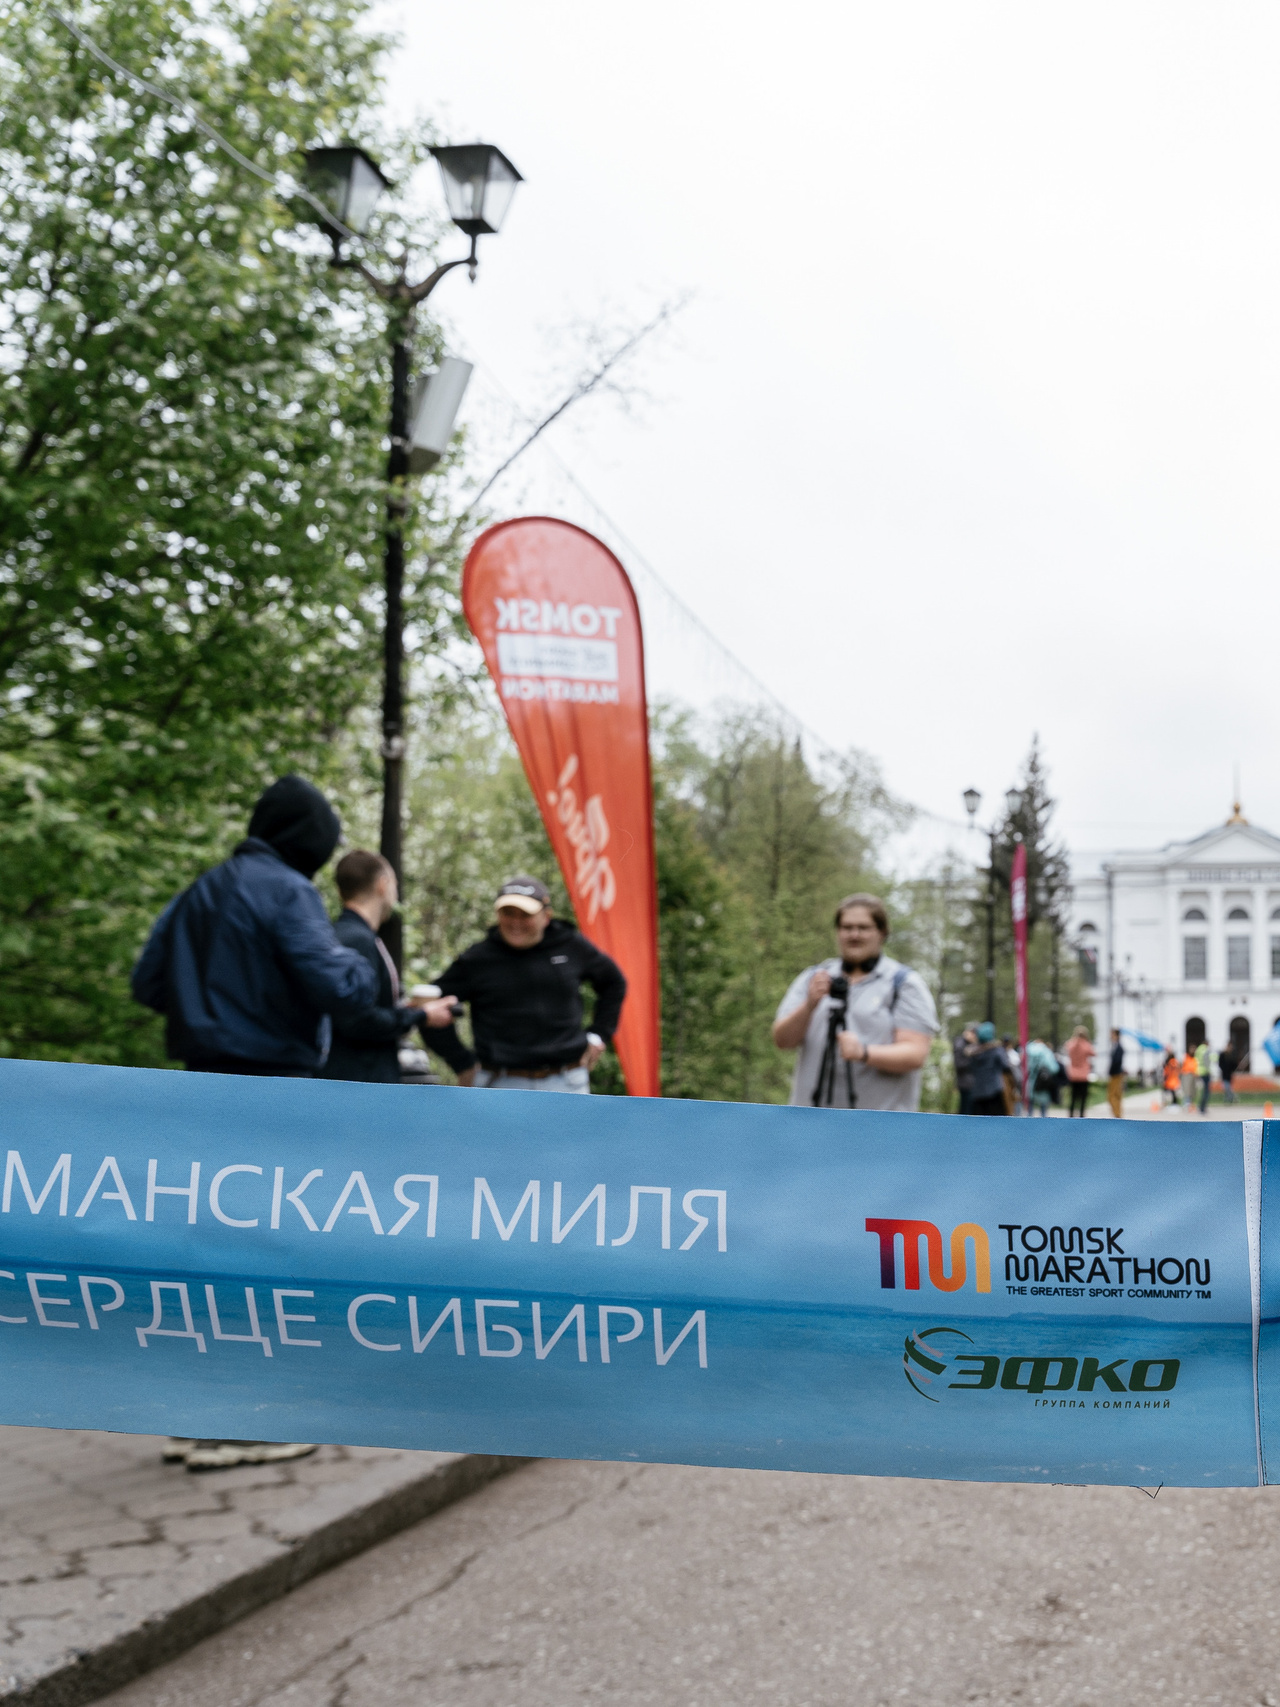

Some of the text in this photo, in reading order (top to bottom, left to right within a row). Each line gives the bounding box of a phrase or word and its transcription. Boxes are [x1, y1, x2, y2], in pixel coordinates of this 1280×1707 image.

[2, 1150, 728, 1253] МАНСКАЯ МИЛЯ
[999, 1224, 1125, 1254] TOMSK
[1005, 1254, 1211, 1286] MARATHON
[1006, 1286, 1211, 1299] THE GREATEST SPORT COMMUNITY TM
[347, 1294, 710, 1369] СИБИРИ
[948, 1354, 1181, 1394] ЭФКО
[1034, 1399, 1171, 1409] ГРУППА КОМПАНИЙ
